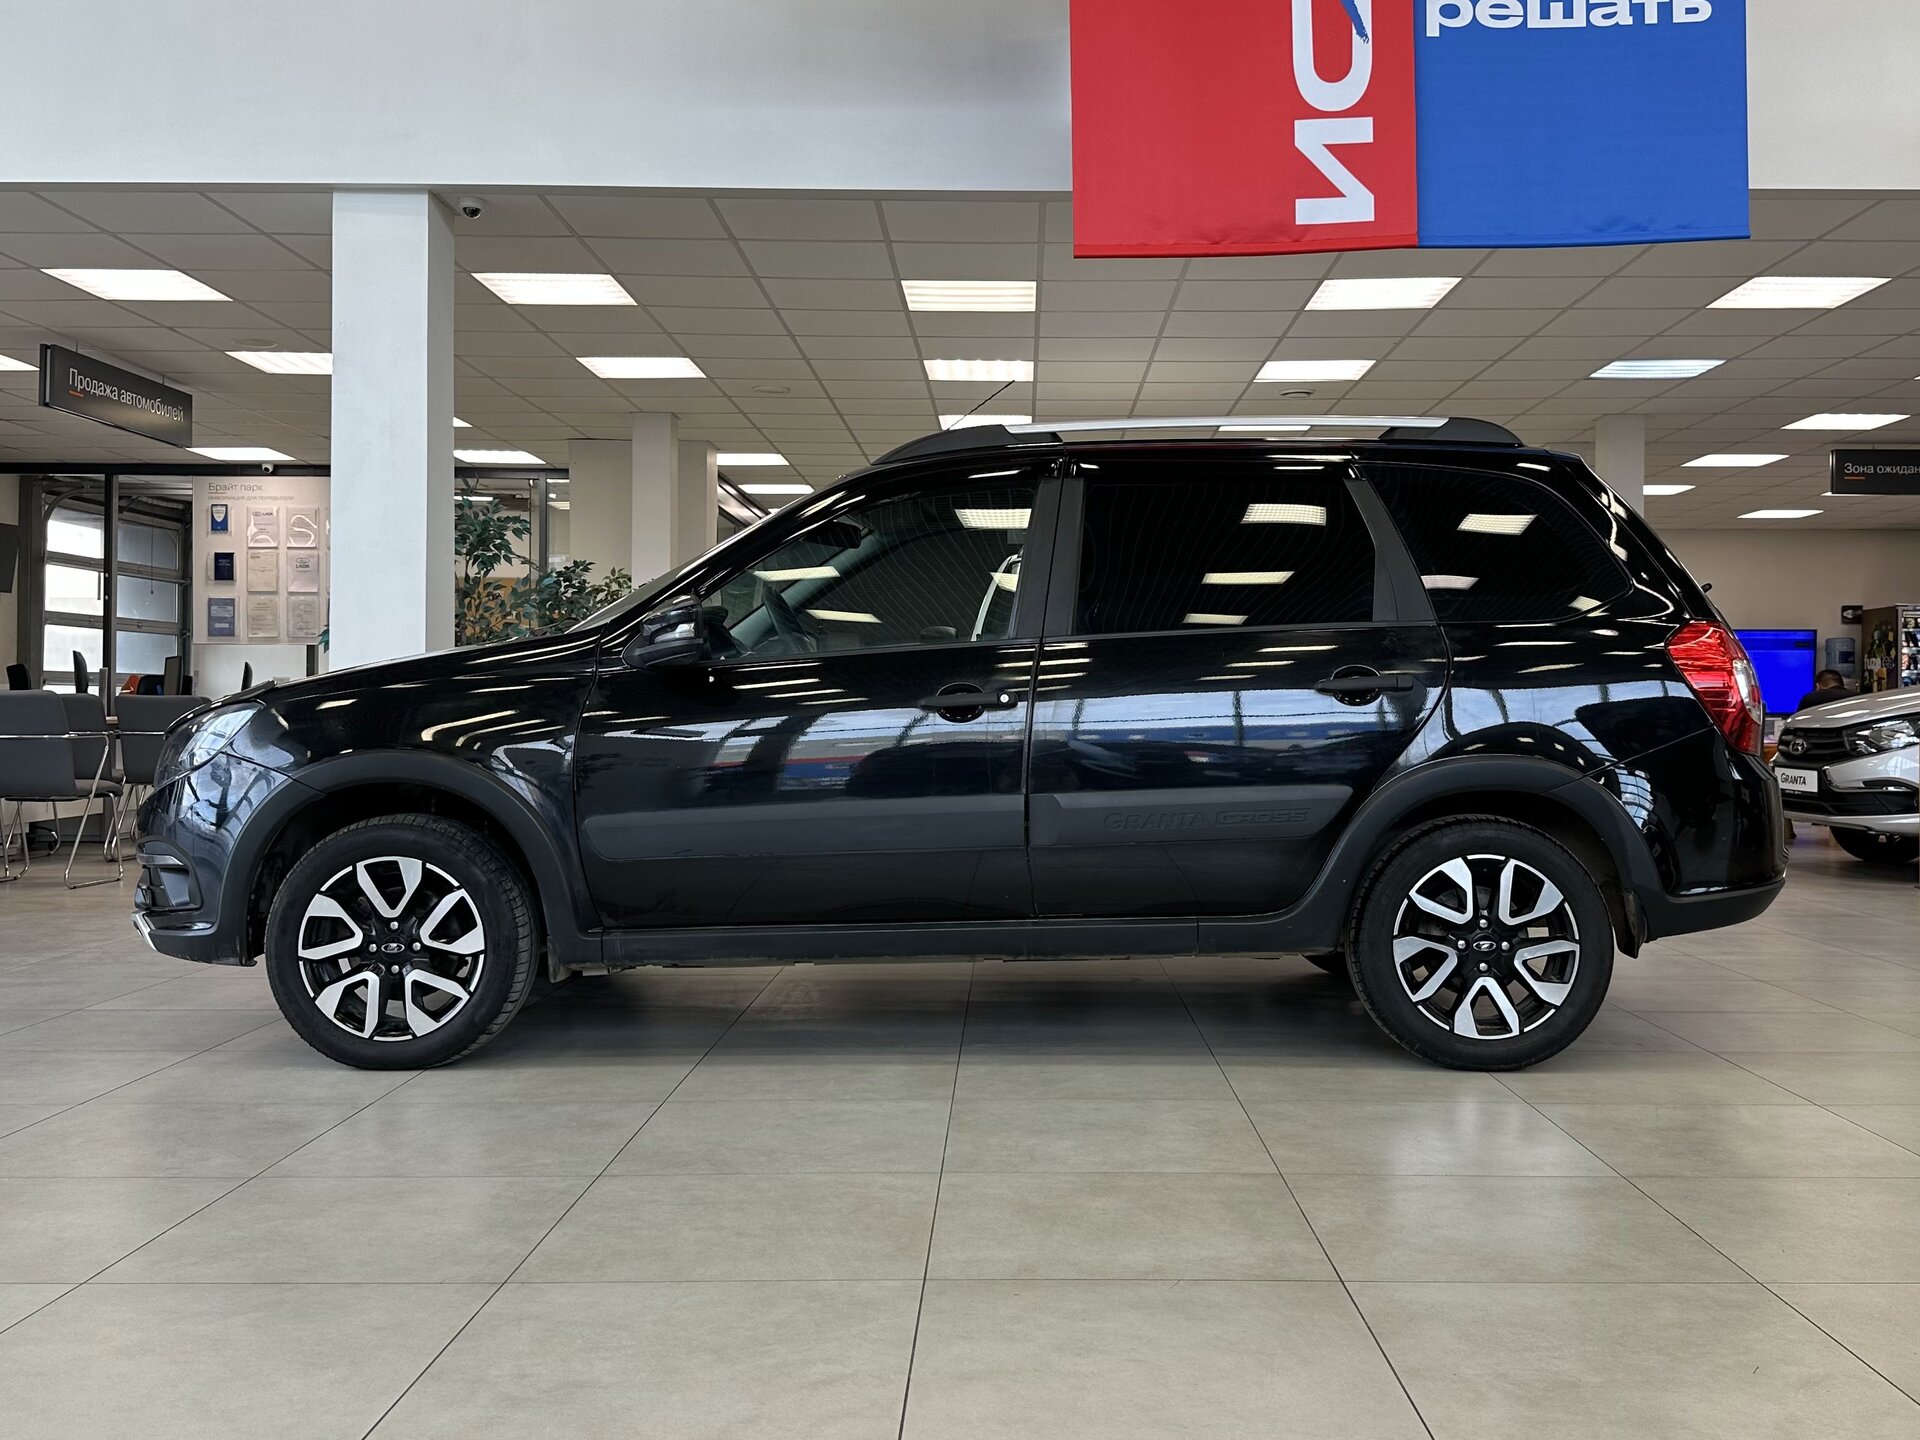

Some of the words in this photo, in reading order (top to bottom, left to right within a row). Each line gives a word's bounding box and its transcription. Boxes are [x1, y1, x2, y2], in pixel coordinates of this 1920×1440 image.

[1425, 0, 1713, 37] решать
[69, 367, 119, 400] Продажа
[120, 389, 184, 422] автомобилей
[1844, 462, 1874, 473] Зона
[208, 482, 238, 493] Брайт
[240, 484, 263, 493] парк
[1780, 772, 1807, 786] GRANTA
[1104, 812, 1205, 831] GRANTA
[1217, 809, 1309, 825] CROSS
